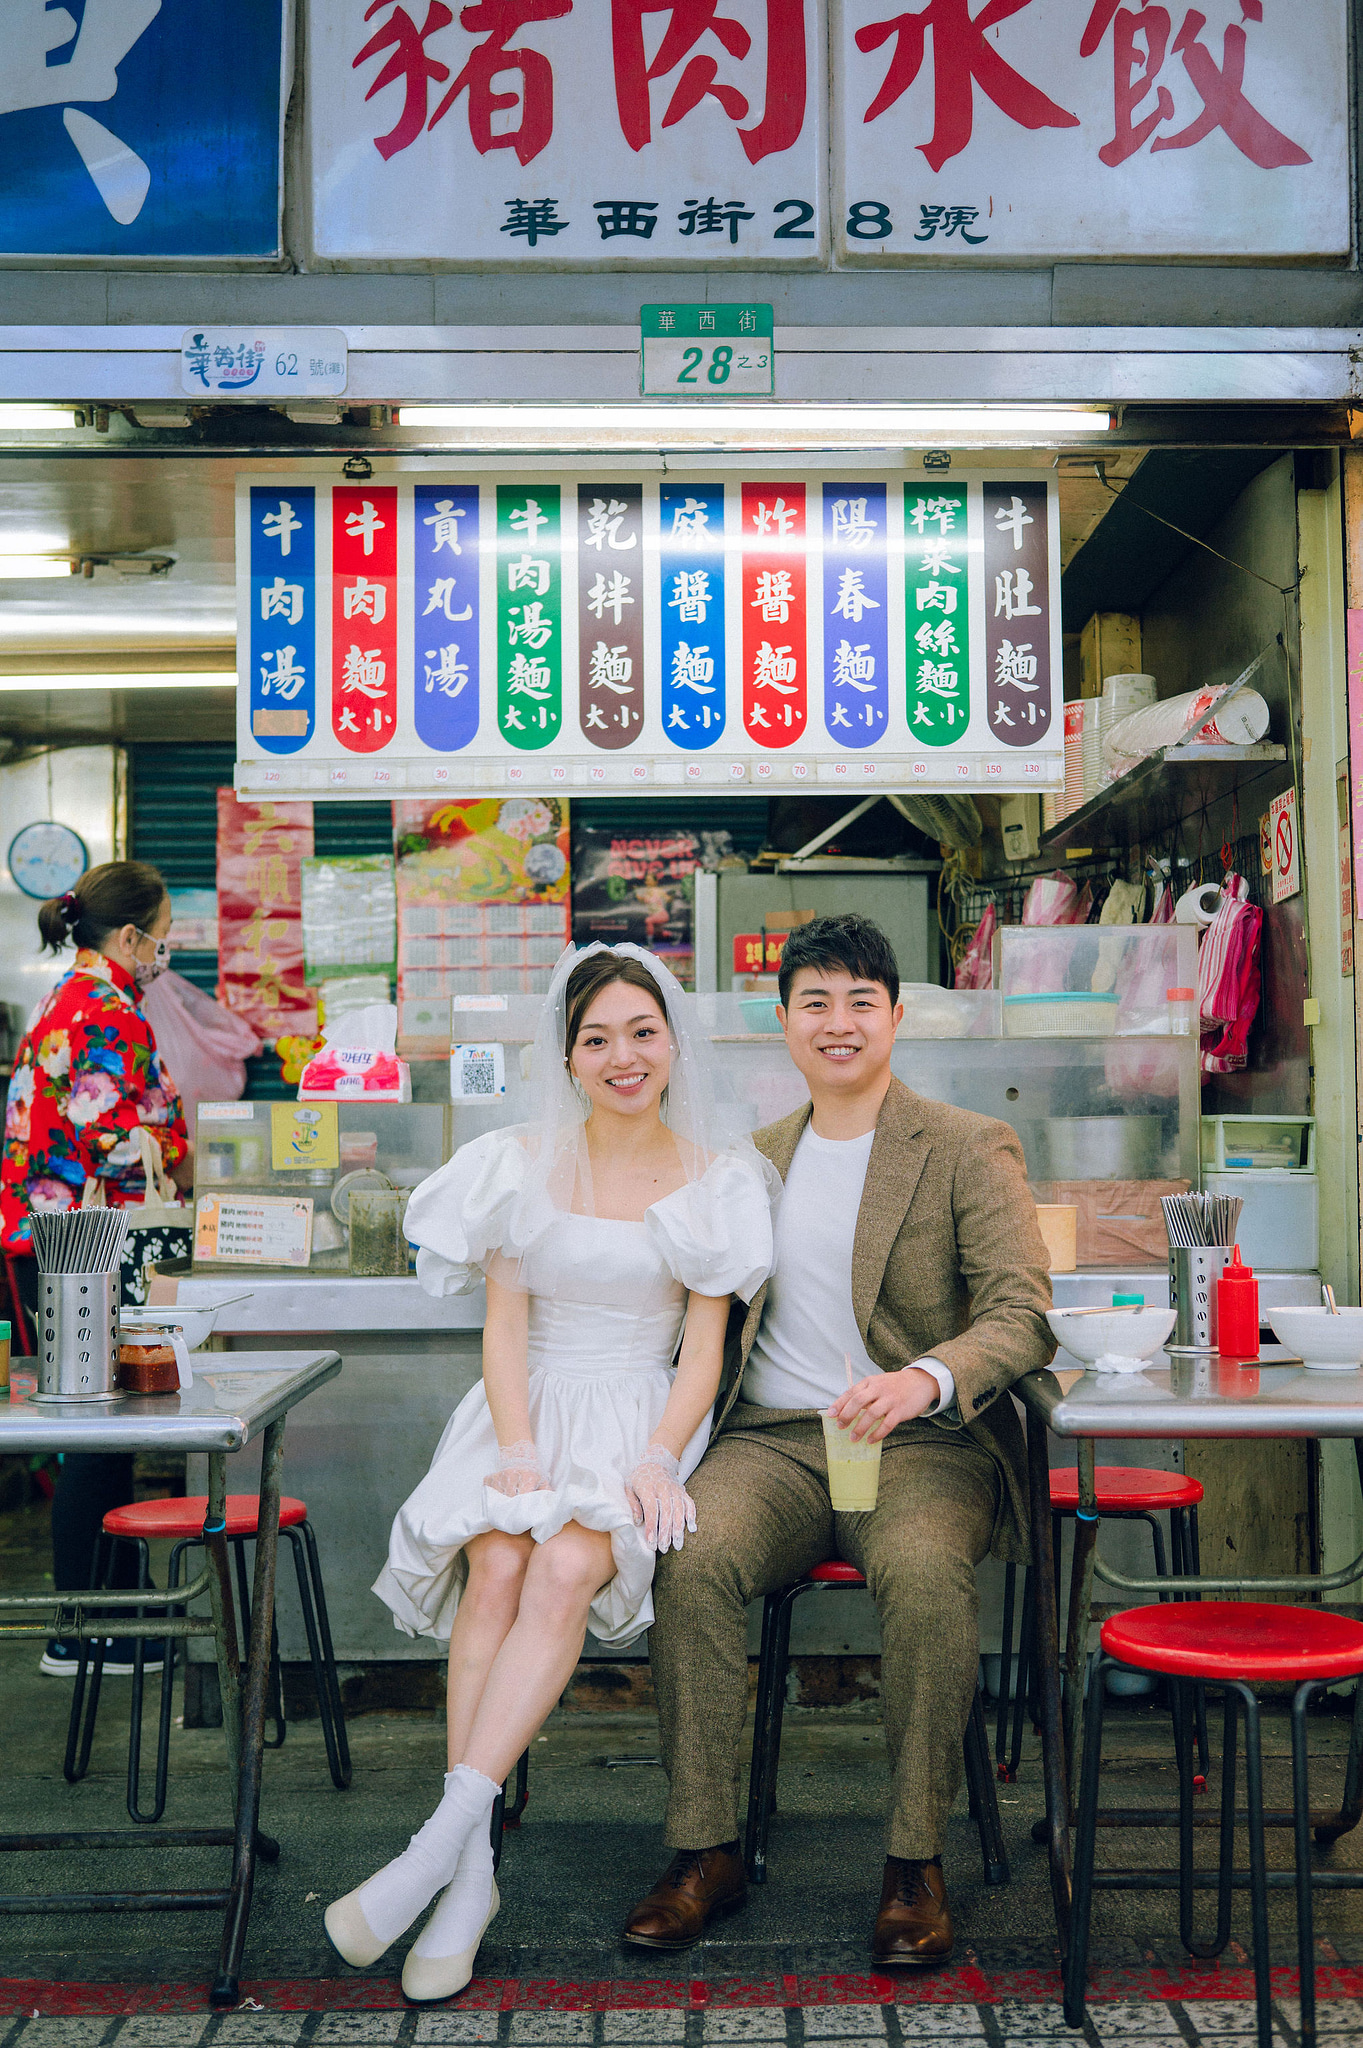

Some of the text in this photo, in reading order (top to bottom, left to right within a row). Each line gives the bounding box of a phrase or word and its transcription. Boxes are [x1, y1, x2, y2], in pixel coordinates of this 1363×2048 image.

[499, 196, 988, 246] 華西街28號
[658, 310, 756, 331] 華西街
[275, 352, 298, 375] 62
[341, 500, 387, 699] 牛肉麵
[421, 499, 473, 699] 貢丸湯
[506, 498, 553, 700] 牛肉湯麵
[584, 498, 637, 695] 乾拌麵
[667, 497, 718, 695] 麻醬麵
[750, 497, 799, 695] 炸醬麵
[830, 496, 881, 693] 陽春麵
[910, 496, 962, 698] 榨菜肉絲麵
[994, 496, 1042, 692] 牛肚麵
[261, 500, 304, 700] 牛肉湯
[509, 768, 522, 779] 80
[553, 768, 565, 779] 70
[592, 767, 604, 778] 70
[633, 767, 646, 778] 60
[688, 766, 701, 777] 80
[731, 765, 743, 776] 70
[758, 764, 770, 775] 80
[794, 764, 806, 776] 70
[835, 764, 847, 775] 60
[863, 764, 876, 775] 50
[913, 763, 926, 774] 80
[956, 764, 968, 776] 70
[986, 764, 1002, 775] 150
[1024, 763, 1040, 774] 130
[264, 772, 280, 782] 120
[331, 771, 347, 781] 140
[374, 771, 391, 781] 120
[434, 769, 448, 780] 30
